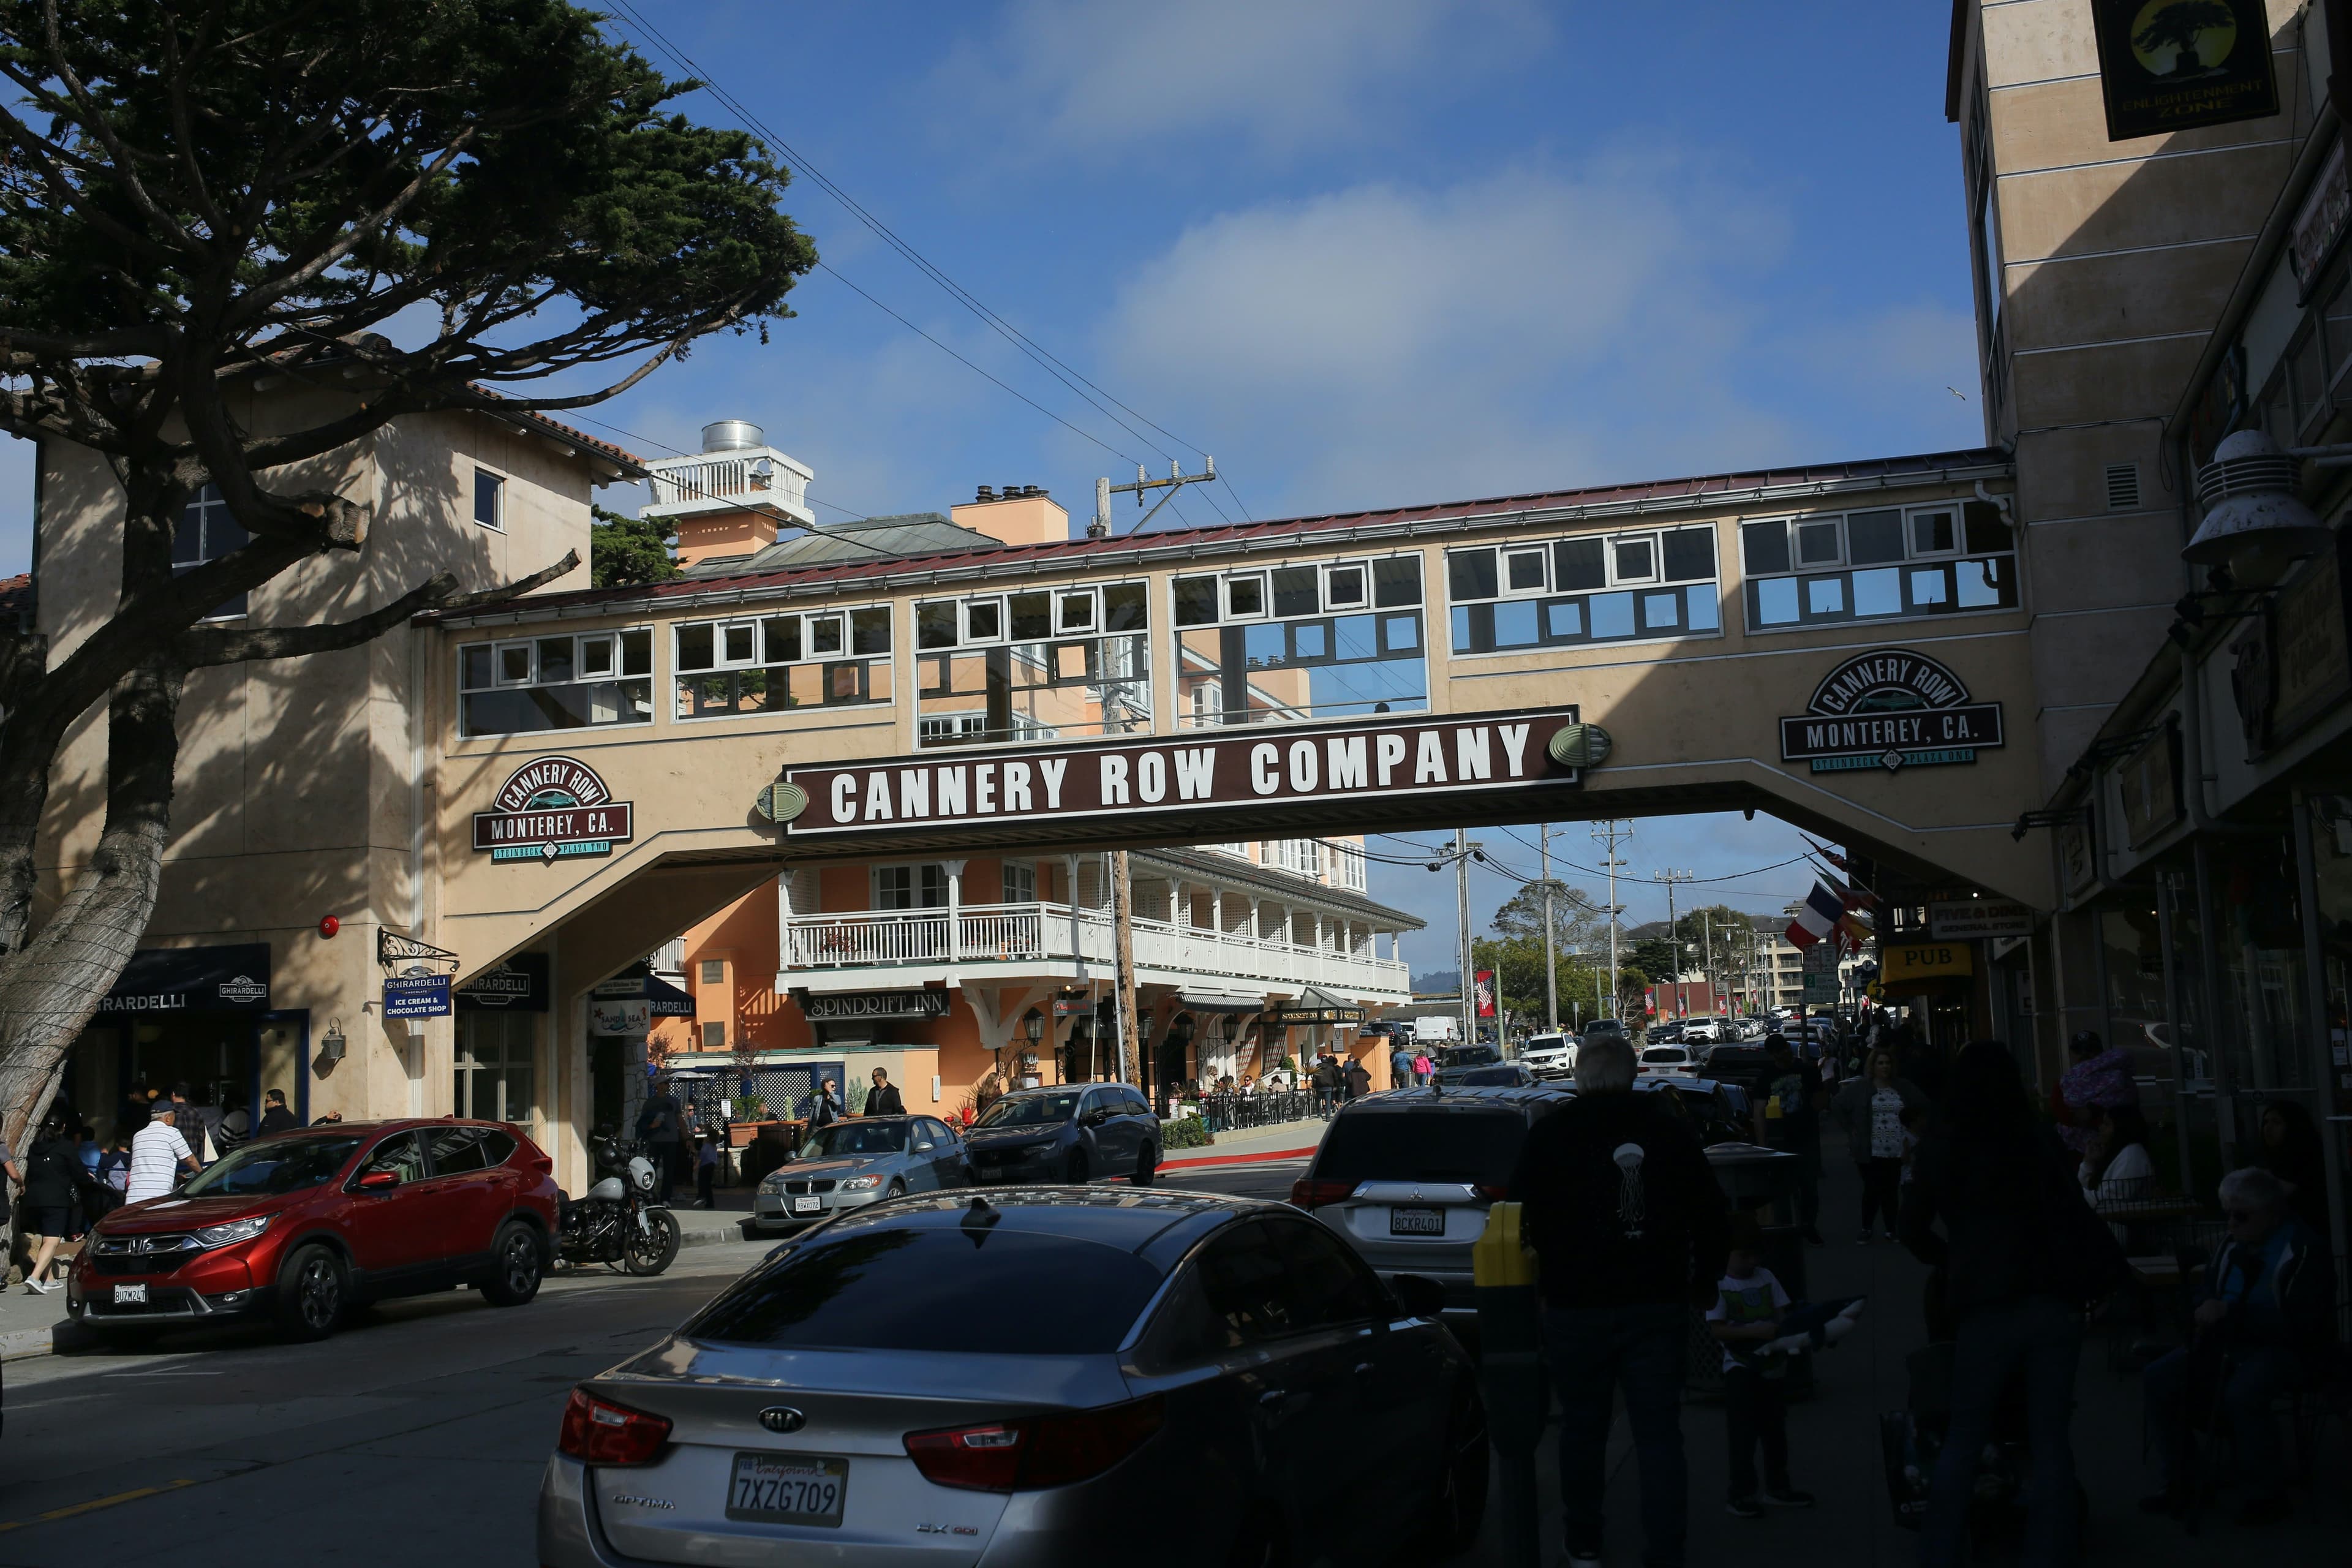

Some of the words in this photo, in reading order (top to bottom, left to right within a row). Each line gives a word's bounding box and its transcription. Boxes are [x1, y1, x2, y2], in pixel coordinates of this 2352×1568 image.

[2122, 79, 2264, 112] ENLIGHTENMENT
[2158, 97, 2235, 118] ZONE
[1822, 658, 1912, 711] CANNERY
[1912, 665, 1957, 705] ROW
[1806, 718, 1932, 748] MONTEREY,
[1942, 715, 1980, 740] CA.
[1815, 756, 1877, 770] STEINBECK
[1910, 751, 1943, 764] PLAZA
[1948, 748, 1971, 761] ONE
[831, 757, 1068, 823] CANNERY
[1100, 747, 1216, 805] ROW
[1250, 723, 1531, 796] COMPANY
[504, 763, 570, 809] CANNERY
[568, 769, 600, 804] ROW
[491, 814, 580, 840] MONTEREY,
[587, 812, 614, 833] CA.
[496, 846, 539, 858] STEINBECK
[564, 844, 587, 854] PLAZA
[590, 842, 607, 851] TWO
[1940, 922, 1990, 932] GENERAL
[1992, 921, 2027, 930] STORE
[1905, 948, 1952, 966] PUB
[386, 978, 446, 989] GHIRARDELLI
[97, 993, 186, 1011] IRARDELLI
[387, 1006, 427, 1015] CHOCOLATE
[650, 1000, 692, 1013] RARDELLI
[812, 995, 907, 1017] SPINDRIFT
[914, 993, 943, 1012] INN
[1395, 1217, 1441, 1230] 8CKR401
[115, 1290, 145, 1302] 8UZM247
[764, 1412, 796, 1428] KIA
[613, 1494, 675, 1509] OPTIMA
[739, 1478, 836, 1513] 7XZG709
[916, 1523, 948, 1534] EX
